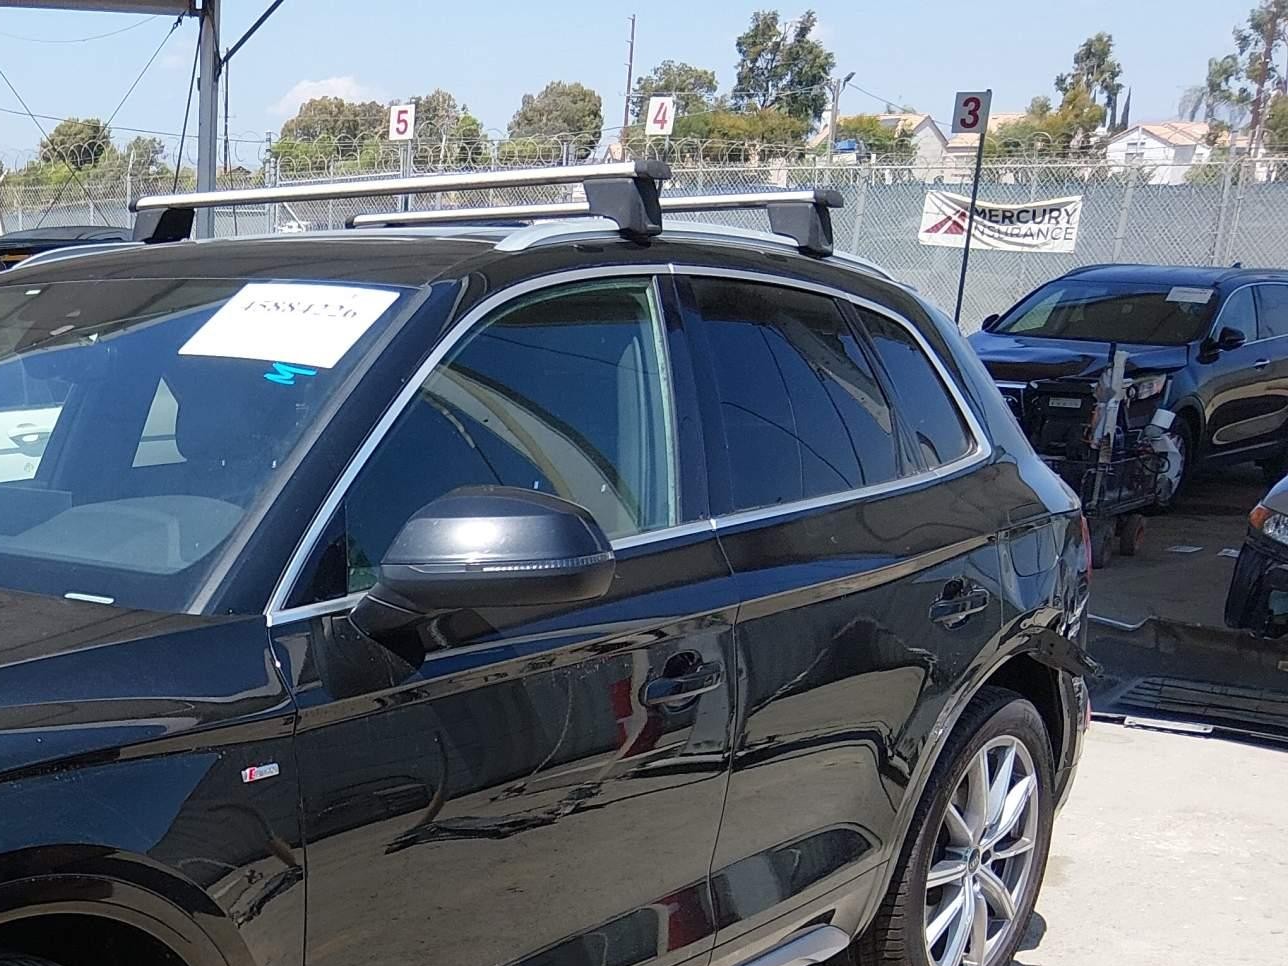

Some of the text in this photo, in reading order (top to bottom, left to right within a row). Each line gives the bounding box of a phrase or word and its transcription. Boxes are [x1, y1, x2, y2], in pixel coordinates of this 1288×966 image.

[395, 109, 409, 135] 5
[652, 102, 668, 129] 4
[960, 97, 981, 128] 3
[972, 207, 1077, 226] MERCURY
[975, 222, 1076, 241] NSURANCE
